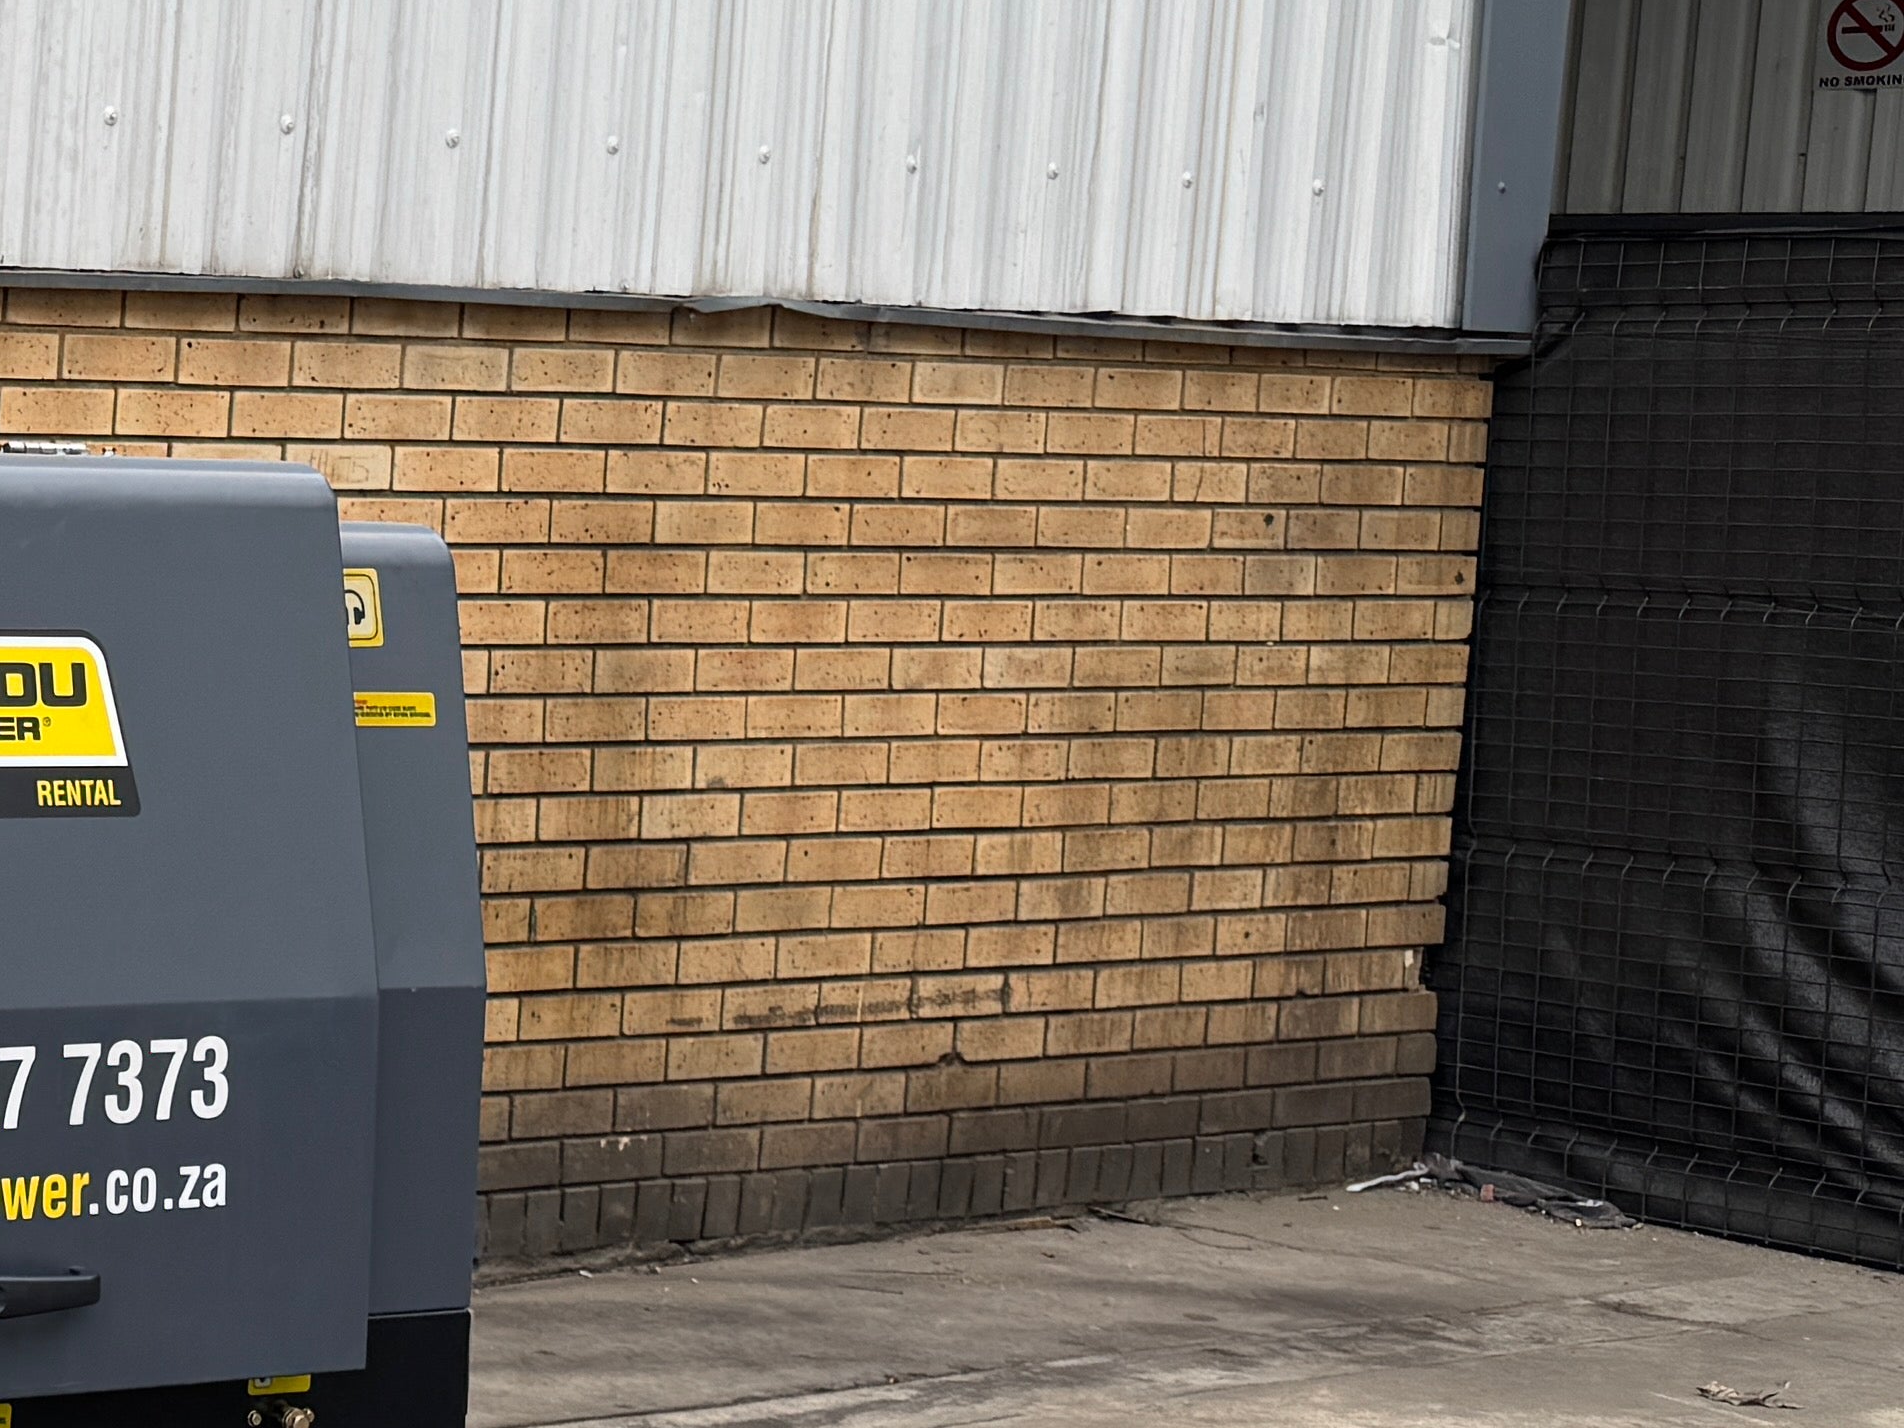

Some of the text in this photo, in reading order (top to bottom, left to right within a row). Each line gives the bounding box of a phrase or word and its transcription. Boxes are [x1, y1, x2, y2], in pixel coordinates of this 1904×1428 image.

[1819, 74, 1904, 88] NO SMOKIN
[36, 779, 122, 808] RENTAL
[62, 1035, 231, 1127] 7373
